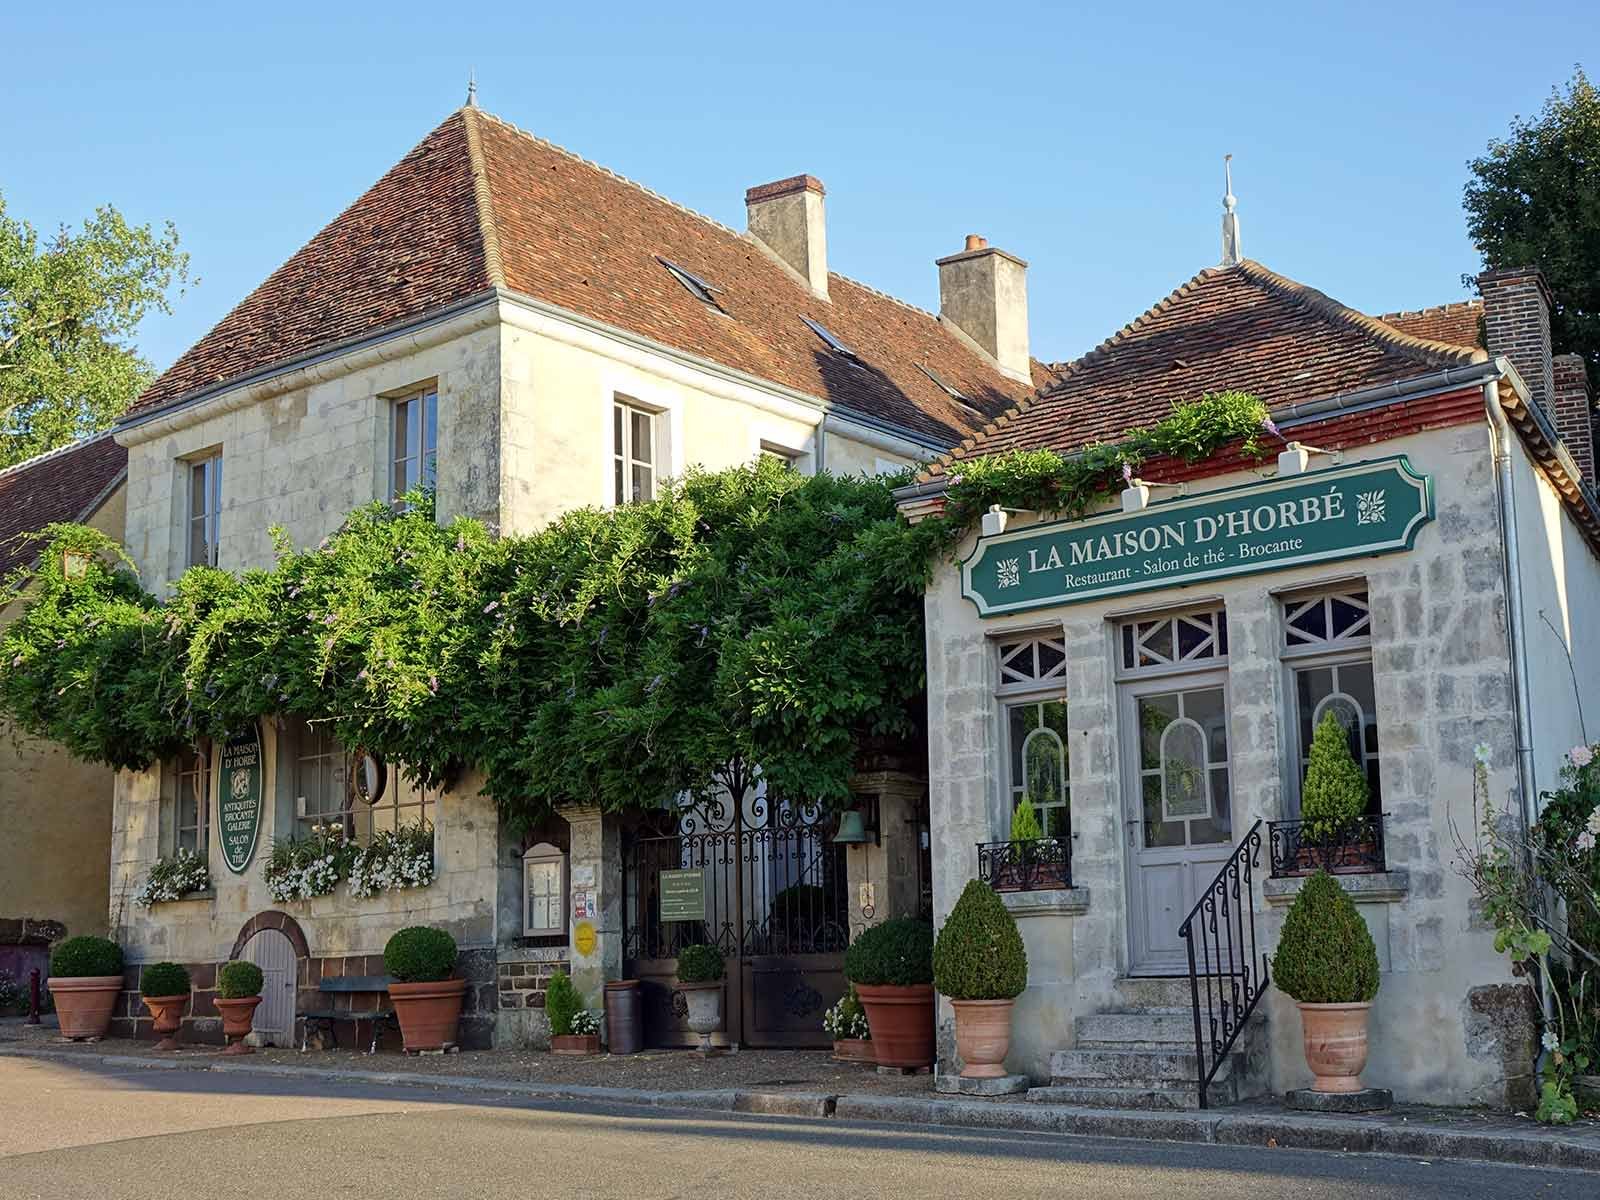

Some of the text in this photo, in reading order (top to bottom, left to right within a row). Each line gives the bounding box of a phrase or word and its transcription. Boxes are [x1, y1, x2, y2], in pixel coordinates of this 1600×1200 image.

[1027, 545, 1064, 573] LA
[1070, 521, 1186, 566] MAISON
[1065, 566, 1131, 588] Restaurant
[1143, 557, 1179, 576] Salon
[1183, 552, 1200, 568] de
[1203, 547, 1225, 566] thé
[1239, 537, 1303, 559] Brocante
[223, 743, 258, 758] LA MAISON
[224, 811, 255, 822] BROCANTE
[227, 821, 252, 832] GALERIE
[228, 834, 249, 846] SALON
[234, 845, 243, 854] de
